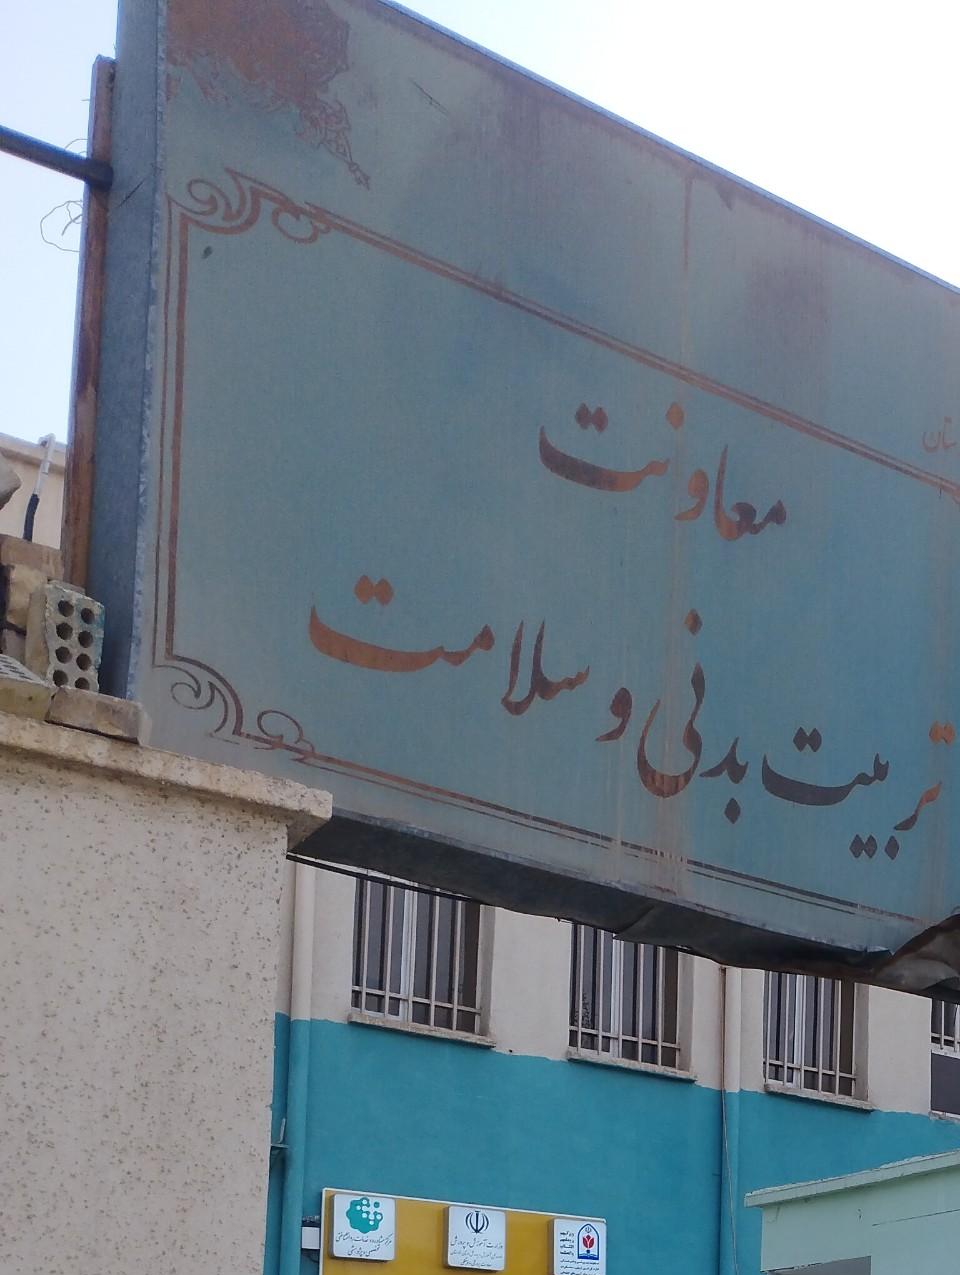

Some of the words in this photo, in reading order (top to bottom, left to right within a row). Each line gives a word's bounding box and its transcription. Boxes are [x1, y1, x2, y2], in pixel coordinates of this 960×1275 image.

[538, 401, 787, 541] معاونت
[309, 573, 590, 716] سلامت
[595, 686, 632, 742] و
[636, 608, 749, 824] بدنی
[761, 721, 956, 861] تربیت
